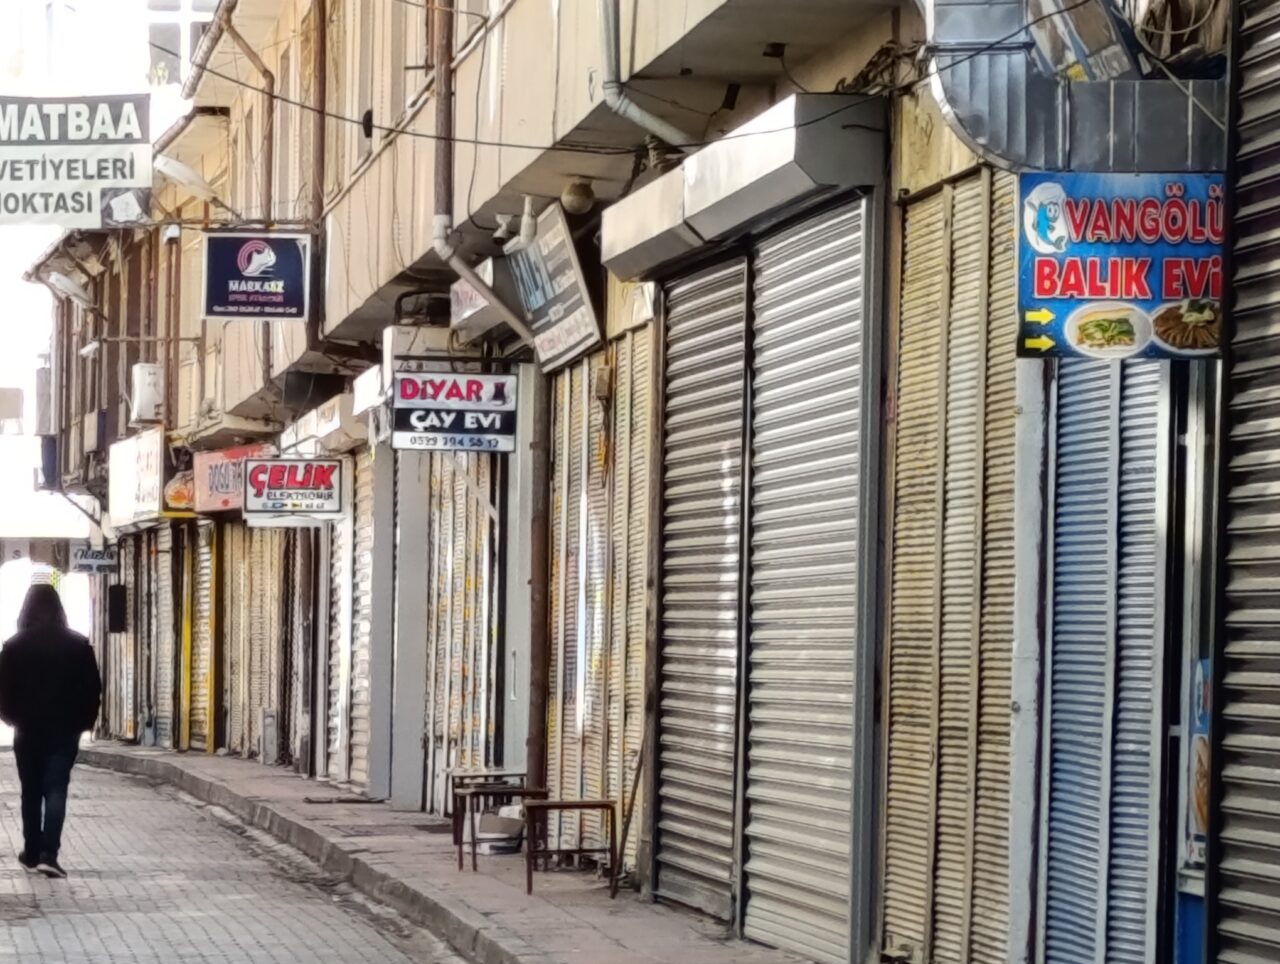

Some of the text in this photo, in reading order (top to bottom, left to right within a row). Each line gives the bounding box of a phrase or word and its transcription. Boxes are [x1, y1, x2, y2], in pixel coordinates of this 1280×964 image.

[1065, 182, 1224, 243] VANGÖLÜ
[1034, 256, 1152, 299] BALIK
[410, 410, 457, 432] ÇAY
[249, 463, 337, 498] ÇELİK
